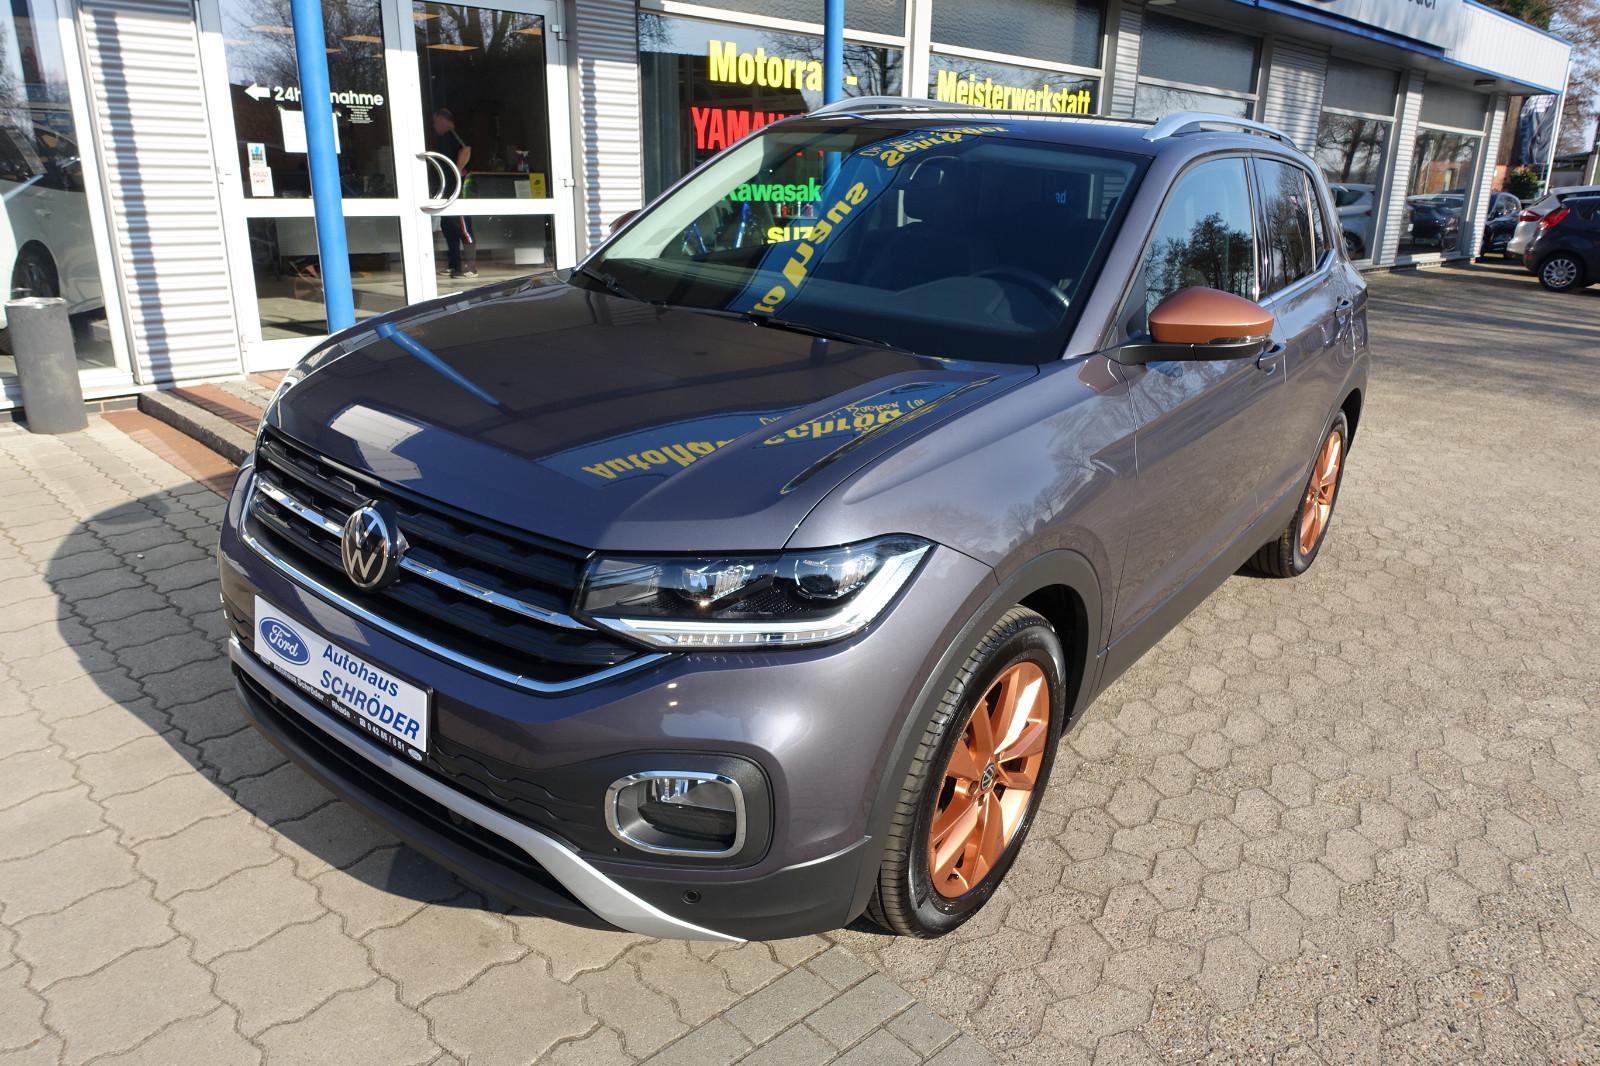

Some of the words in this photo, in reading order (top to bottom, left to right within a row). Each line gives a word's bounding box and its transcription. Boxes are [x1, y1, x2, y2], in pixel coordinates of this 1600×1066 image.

[937, 69, 1090, 115] Meisterwerkstatt
[268, 623, 299, 657] Ford
[322, 644, 399, 697] Autohaus
[320, 669, 420, 741] SCHRÖDER
